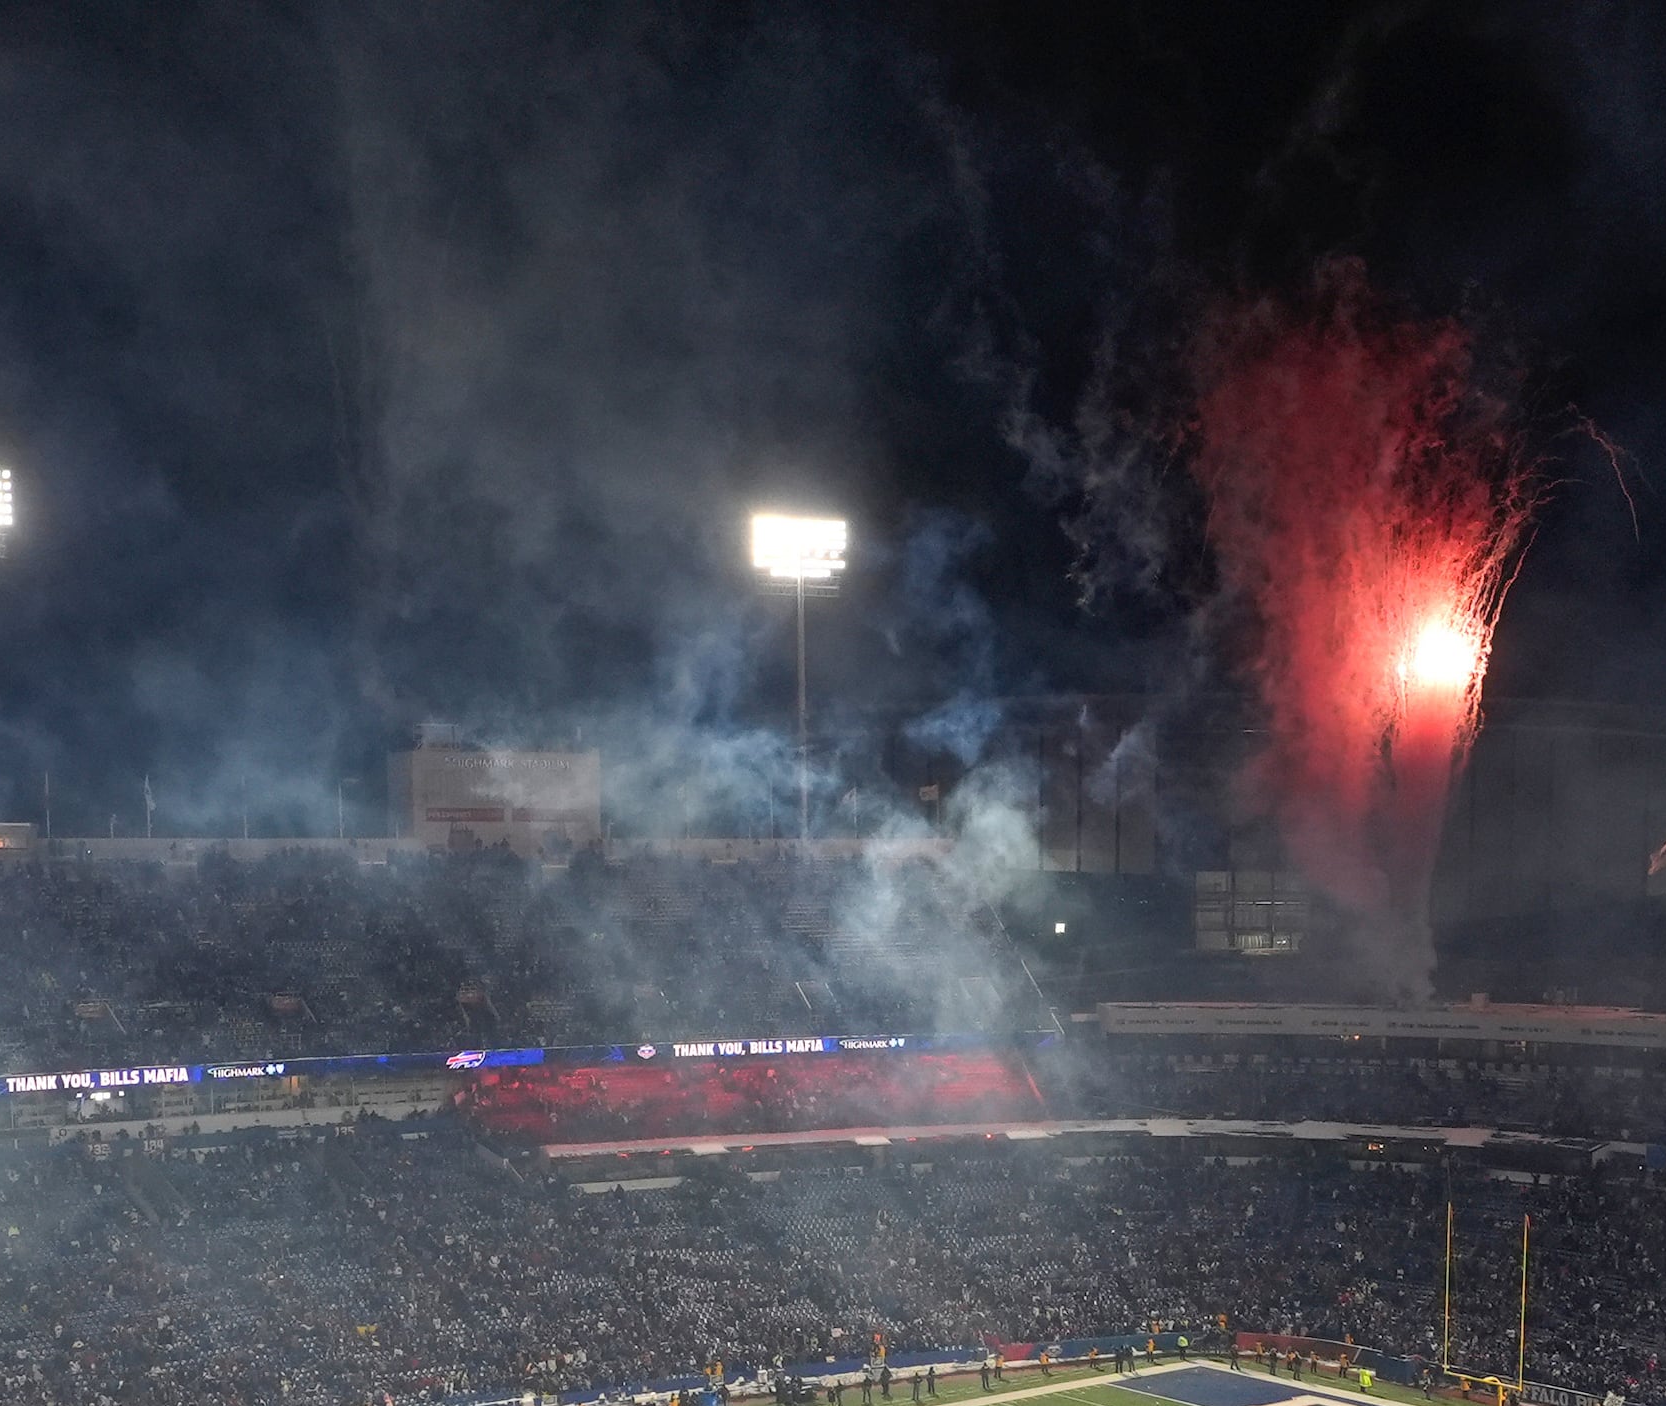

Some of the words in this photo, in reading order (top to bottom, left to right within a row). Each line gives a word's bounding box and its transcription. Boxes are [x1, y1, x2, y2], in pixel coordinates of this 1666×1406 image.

[673, 1042, 714, 1057] THANK
[717, 1040, 746, 1057] YOU,
[749, 1040, 783, 1055] BILLS
[786, 1038, 824, 1054] MAFIA
[842, 1038, 888, 1049] HIGHMARK
[6, 1074, 57, 1092] THANK
[61, 1071, 96, 1090] YOU,
[100, 1068, 140, 1086] BILLS
[143, 1066, 189, 1085] MAFIA
[211, 1065, 265, 1079] HIGHMARK
